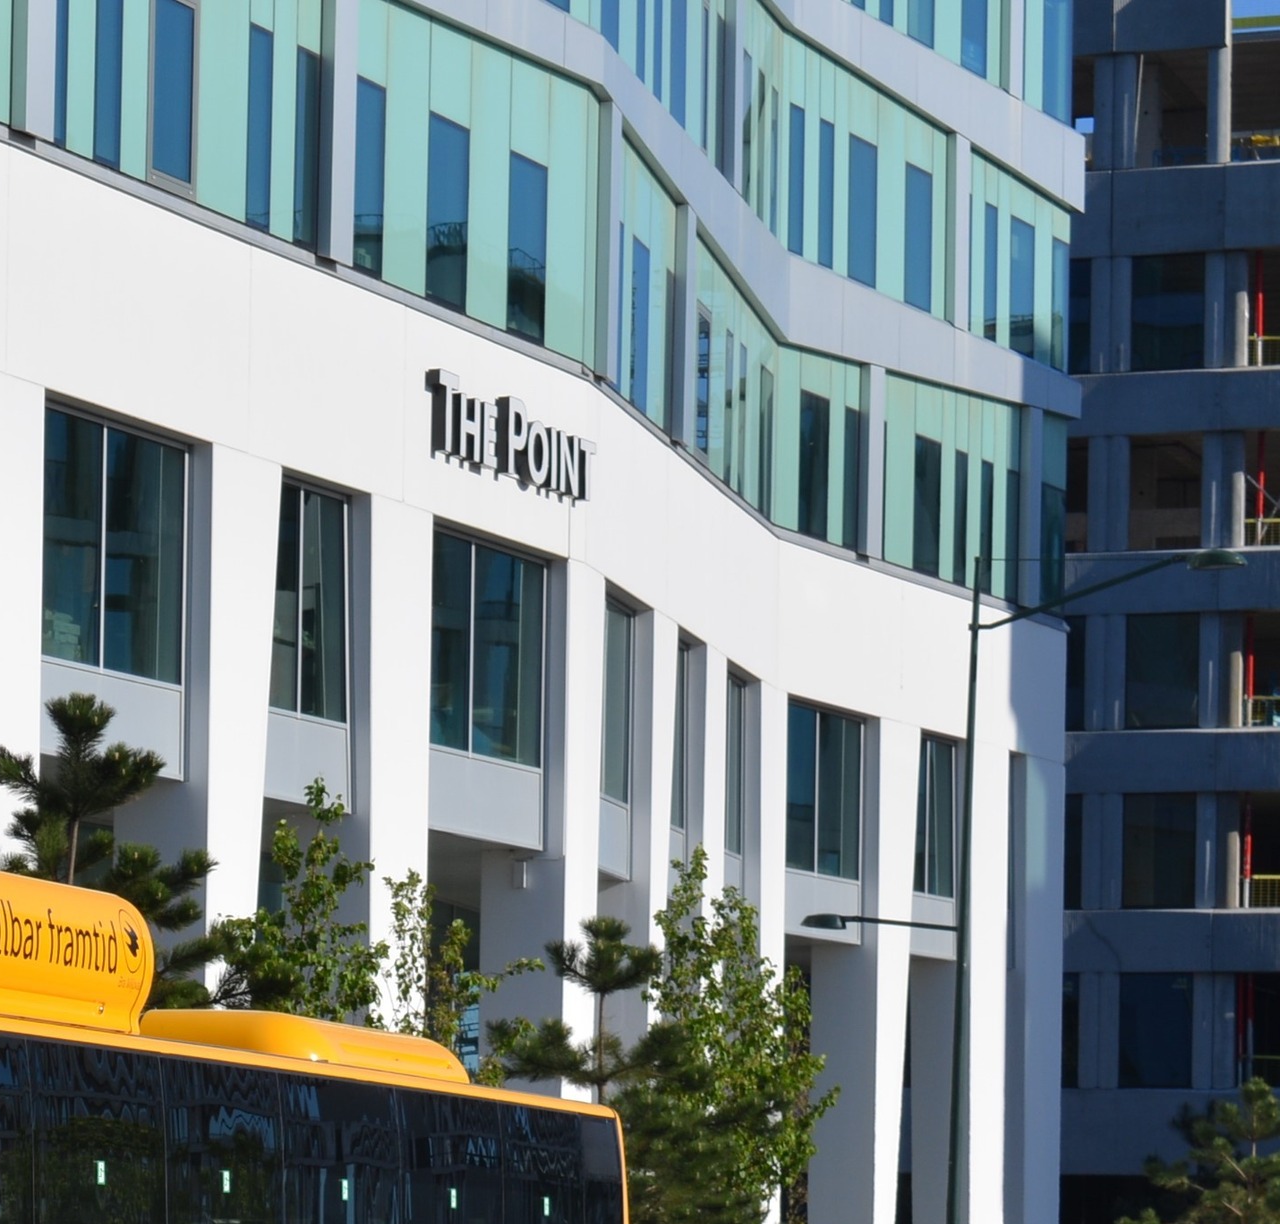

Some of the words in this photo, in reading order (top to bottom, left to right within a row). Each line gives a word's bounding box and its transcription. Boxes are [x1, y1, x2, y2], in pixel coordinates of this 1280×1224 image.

[424, 368, 498, 474] THE
[496, 395, 597, 504] POINT
[47, 908, 118, 975] framtid
